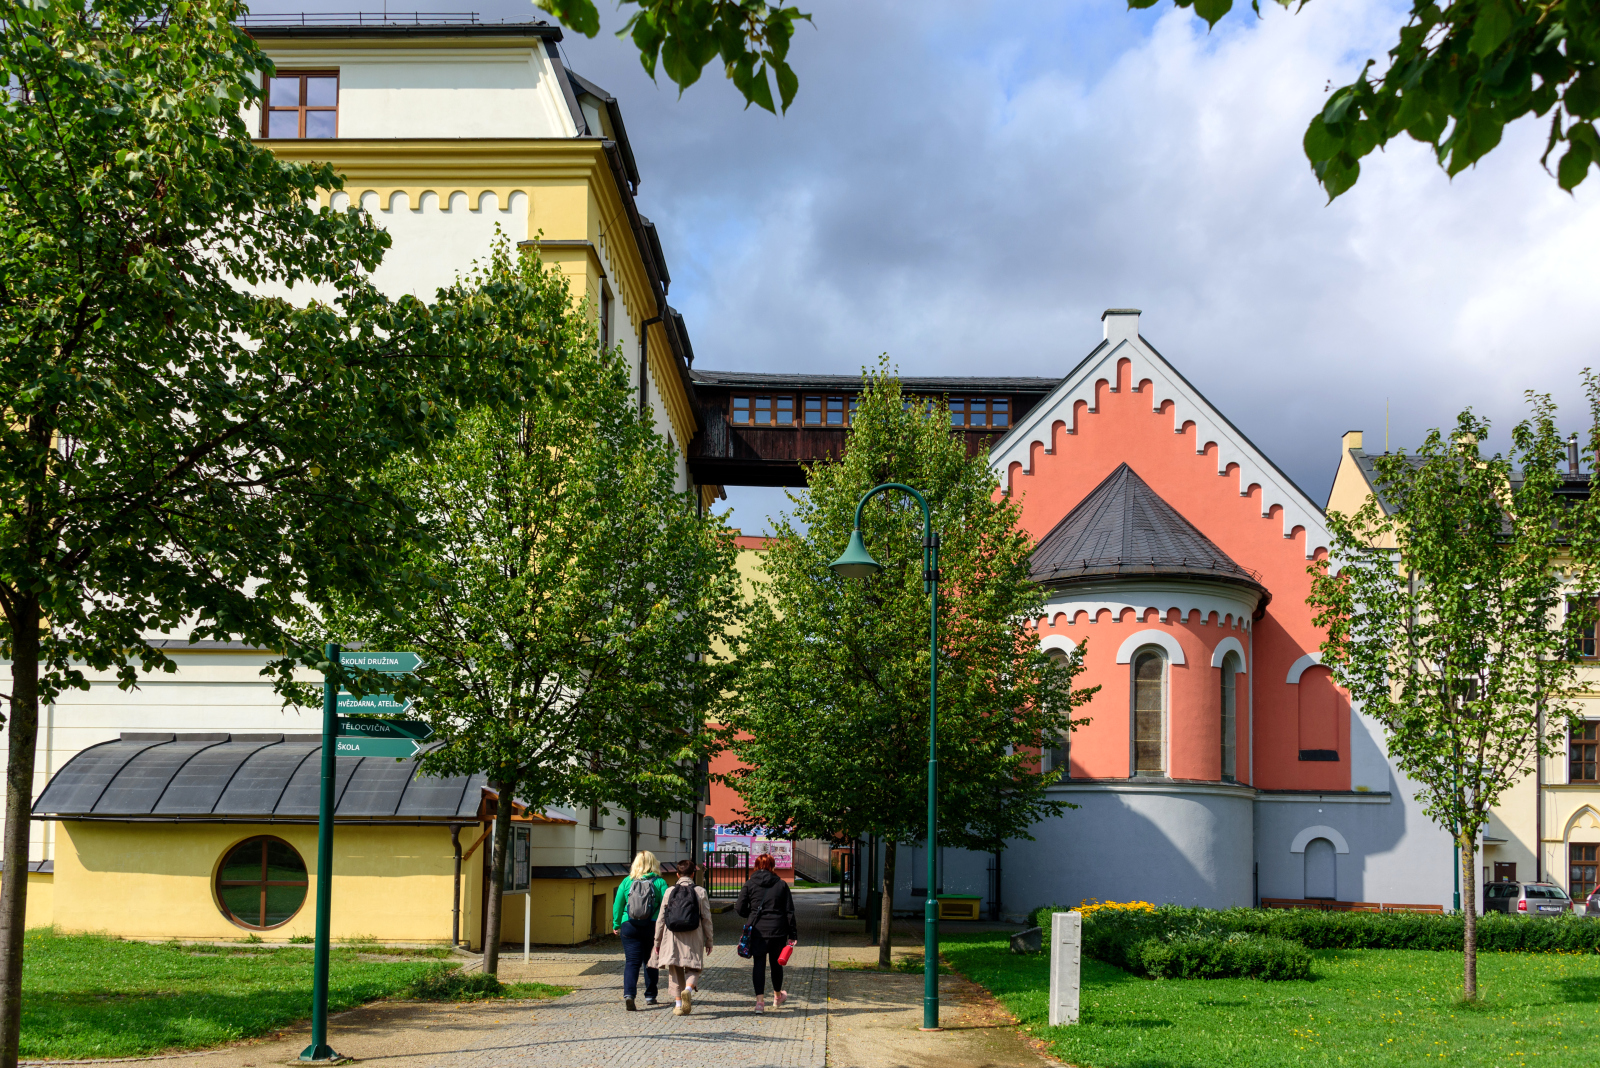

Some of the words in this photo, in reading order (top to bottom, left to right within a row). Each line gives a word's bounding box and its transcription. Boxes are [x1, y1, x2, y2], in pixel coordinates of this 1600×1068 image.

[341, 656, 366, 665] ŠKOLNÍ
[367, 656, 399, 665] DRUŽINA
[341, 721, 391, 732] TĚLOCVIČNA
[337, 741, 360, 751] ŠKOLA
